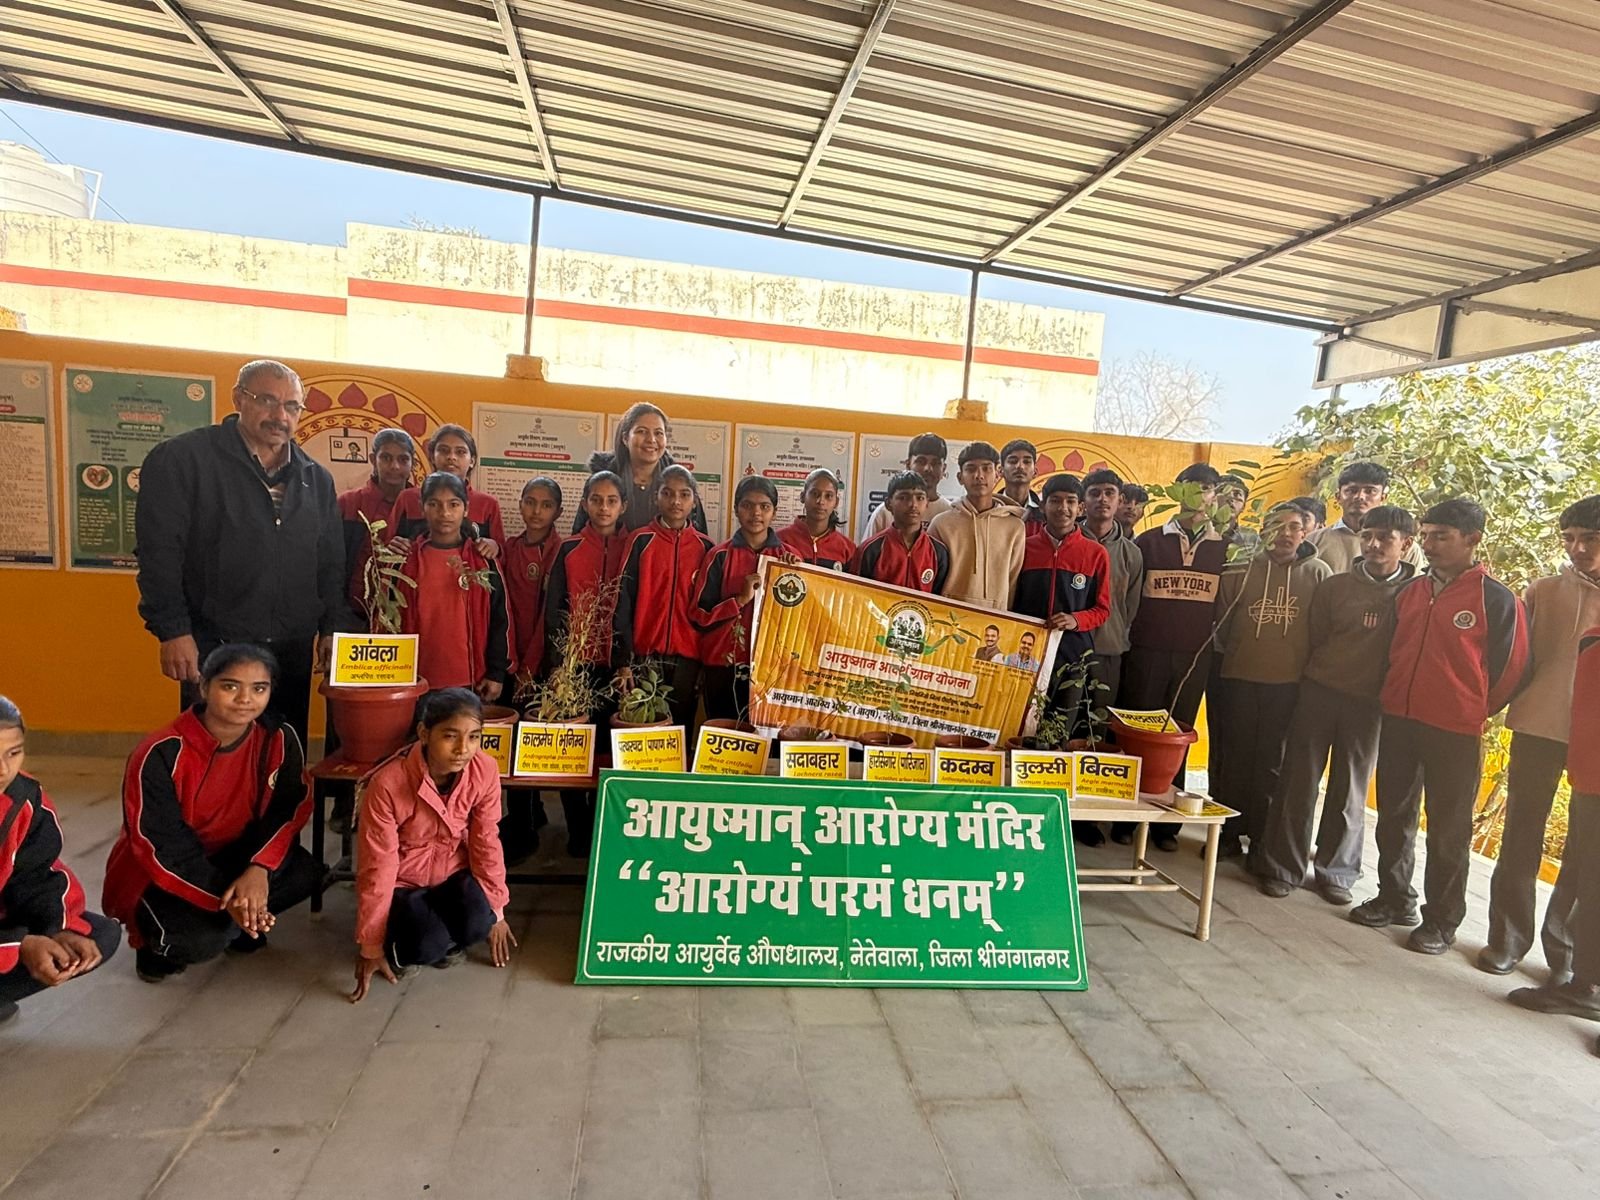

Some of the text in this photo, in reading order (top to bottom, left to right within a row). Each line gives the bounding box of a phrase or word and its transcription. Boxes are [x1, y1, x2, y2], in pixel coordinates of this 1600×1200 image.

[1154, 576, 1212, 592] NEW YORK
[349, 638, 399, 662] आंवला
[825, 651, 877, 670] आयुष्मान
[910, 667, 933, 683] ग्राम
[935, 671, 971, 690] योजना
[772, 692, 804, 705] आयुष्मान
[522, 728, 554, 747] कालमेघ
[706, 734, 760, 754] गुलाब
[786, 752, 840, 770] सदाबहार
[940, 757, 995, 776] कदम्ब
[1014, 758, 1068, 779] तुलसी
[1079, 755, 1131, 779] बिल्व
[624, 796, 1045, 854] आयुष्मान् आरोग्य मंदिर
[810, 864, 894, 918] परमं
[597, 934, 1070, 974] राजकीय आयुर्वेद औषधालय, नेतेवाला, जिला श्रीगंगानगर
